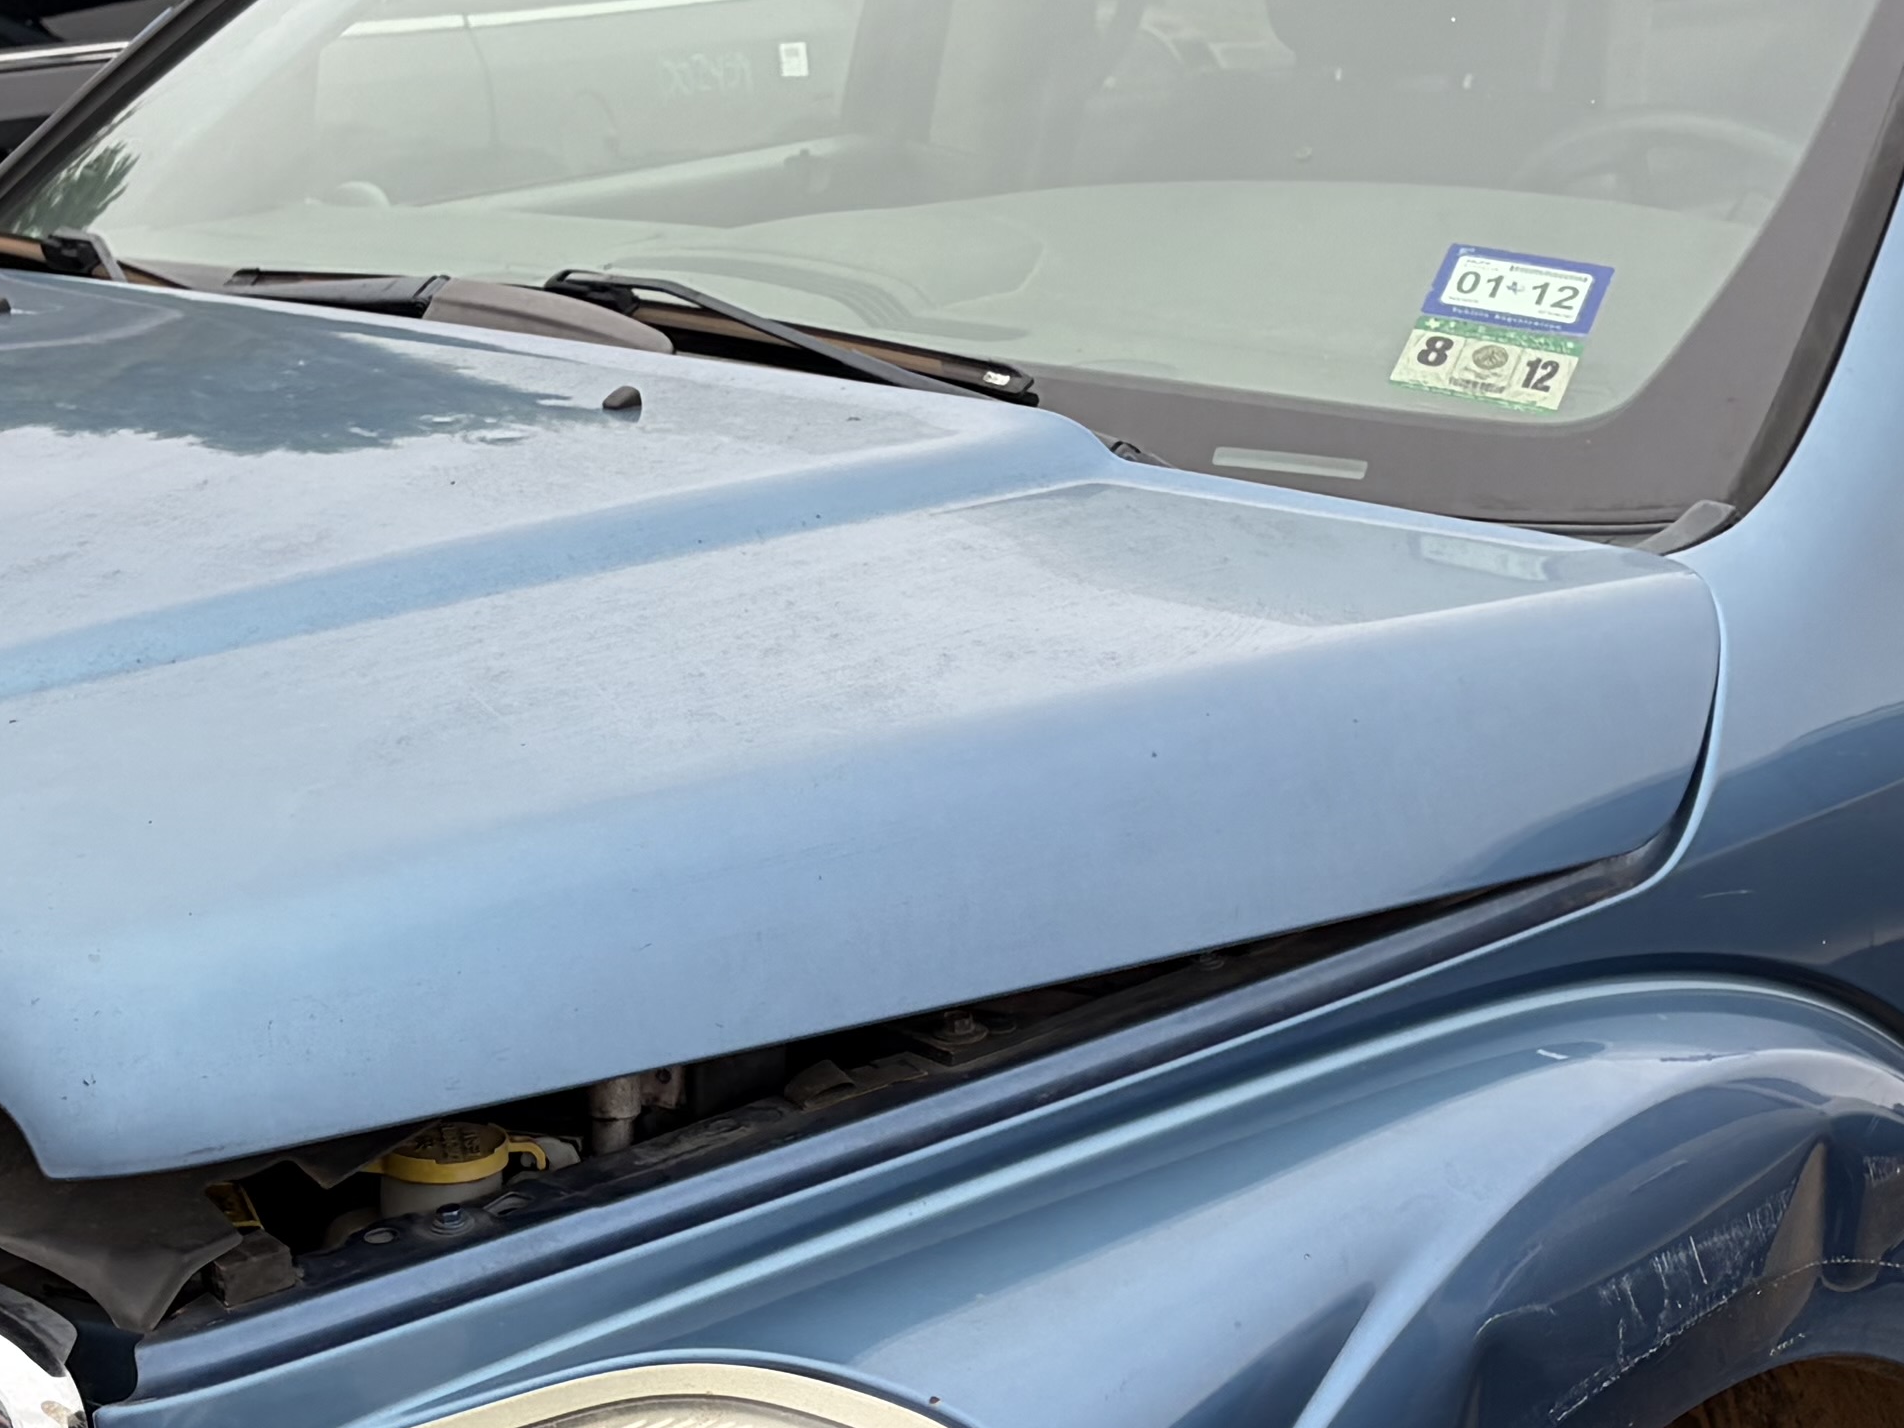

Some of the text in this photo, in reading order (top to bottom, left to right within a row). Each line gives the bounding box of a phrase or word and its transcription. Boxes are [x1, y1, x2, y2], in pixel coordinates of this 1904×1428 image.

[1455, 270, 1581, 311] 01 12
[1416, 335, 1455, 368] 8
[1520, 357, 1561, 394] 12
